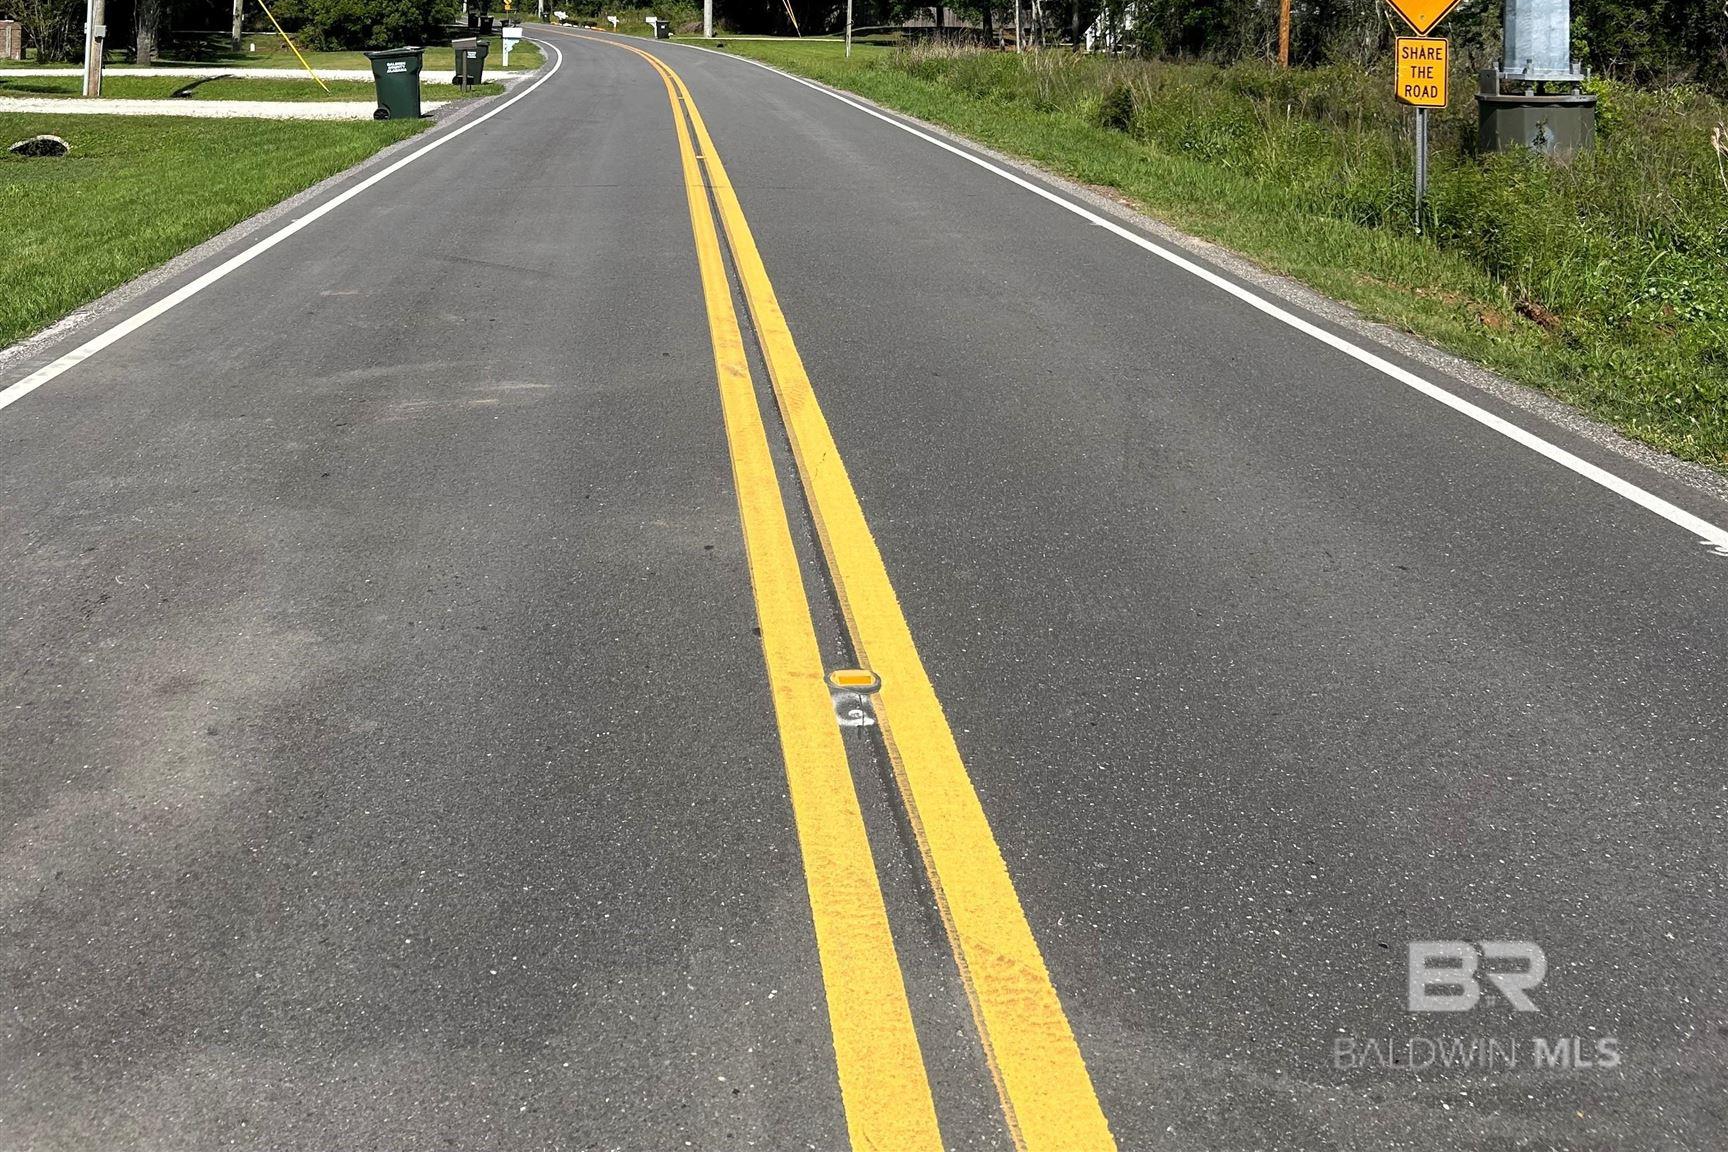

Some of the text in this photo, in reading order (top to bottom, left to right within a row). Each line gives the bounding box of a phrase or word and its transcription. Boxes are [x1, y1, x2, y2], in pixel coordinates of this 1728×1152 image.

[1402, 46, 1443, 60] SHARE
[1411, 65, 1434, 79] THE
[1404, 84, 1438, 98] ROAD
